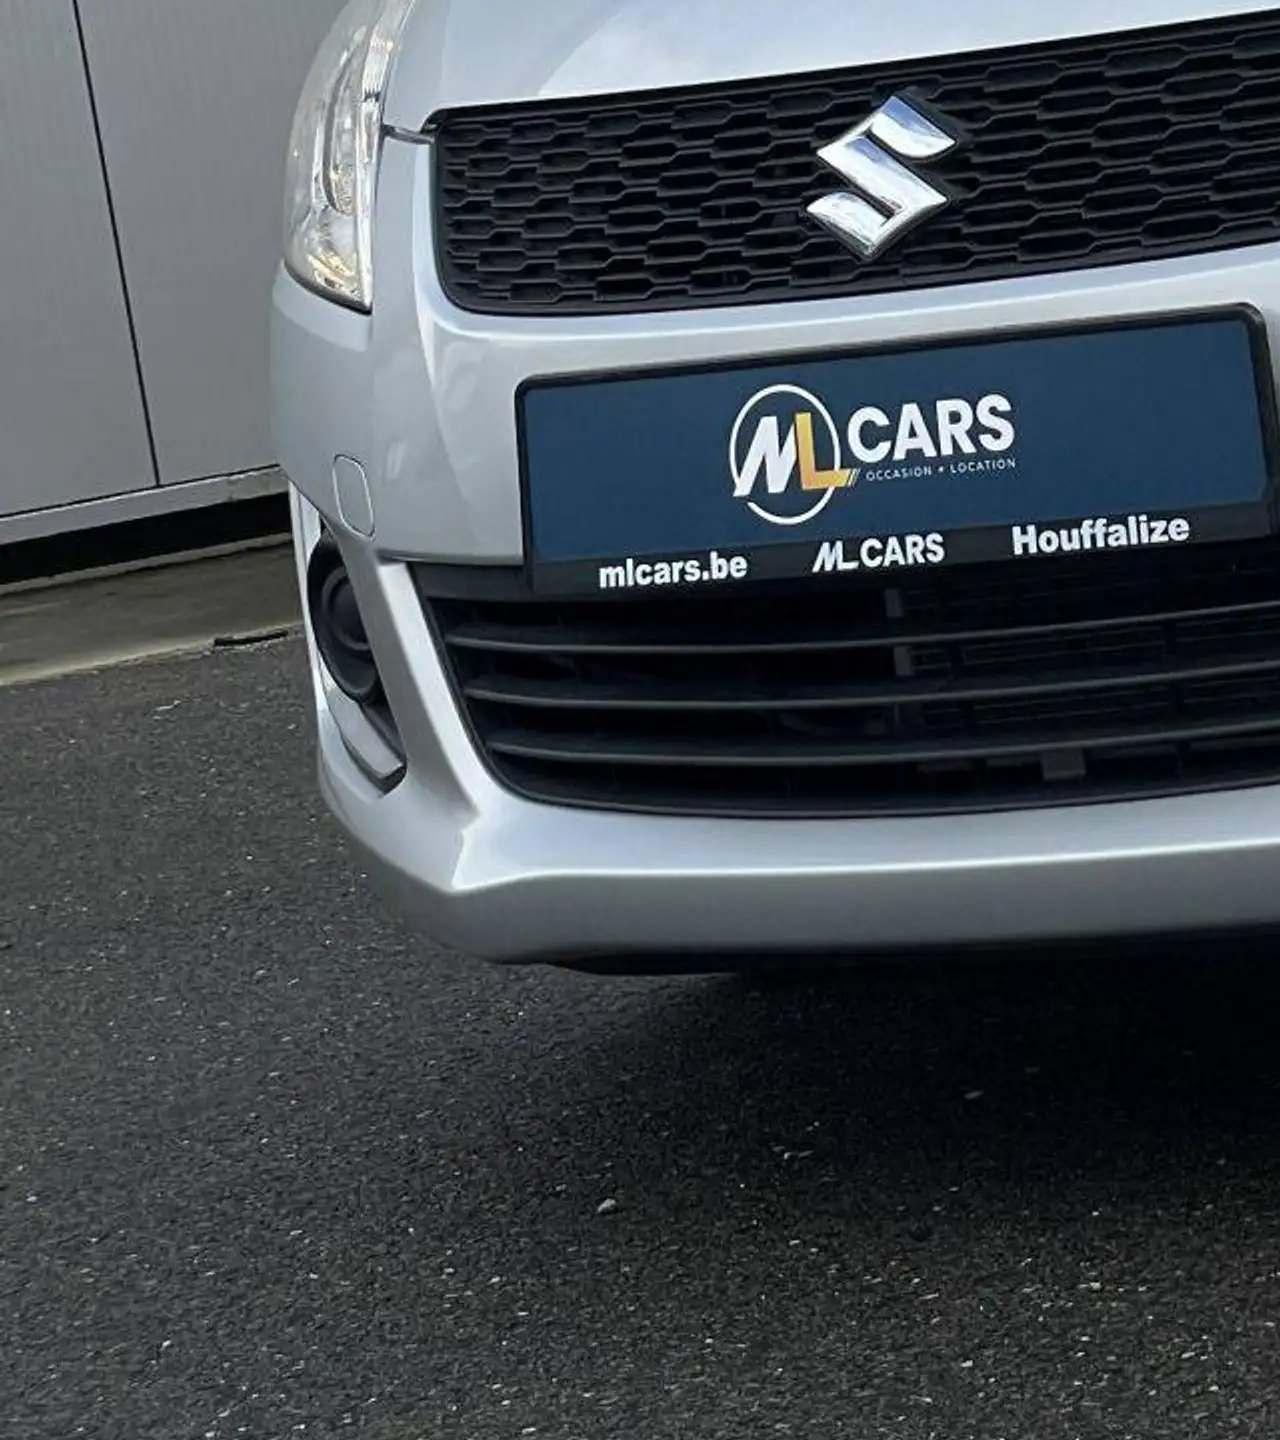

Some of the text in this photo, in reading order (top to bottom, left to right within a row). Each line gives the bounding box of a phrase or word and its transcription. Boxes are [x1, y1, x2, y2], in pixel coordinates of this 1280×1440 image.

[732, 393, 1016, 498] ML CARS
[865, 457, 1017, 482] OCCASION LOCATION
[599, 515, 1191, 589] mlcars.be ML CARS Houffalize
